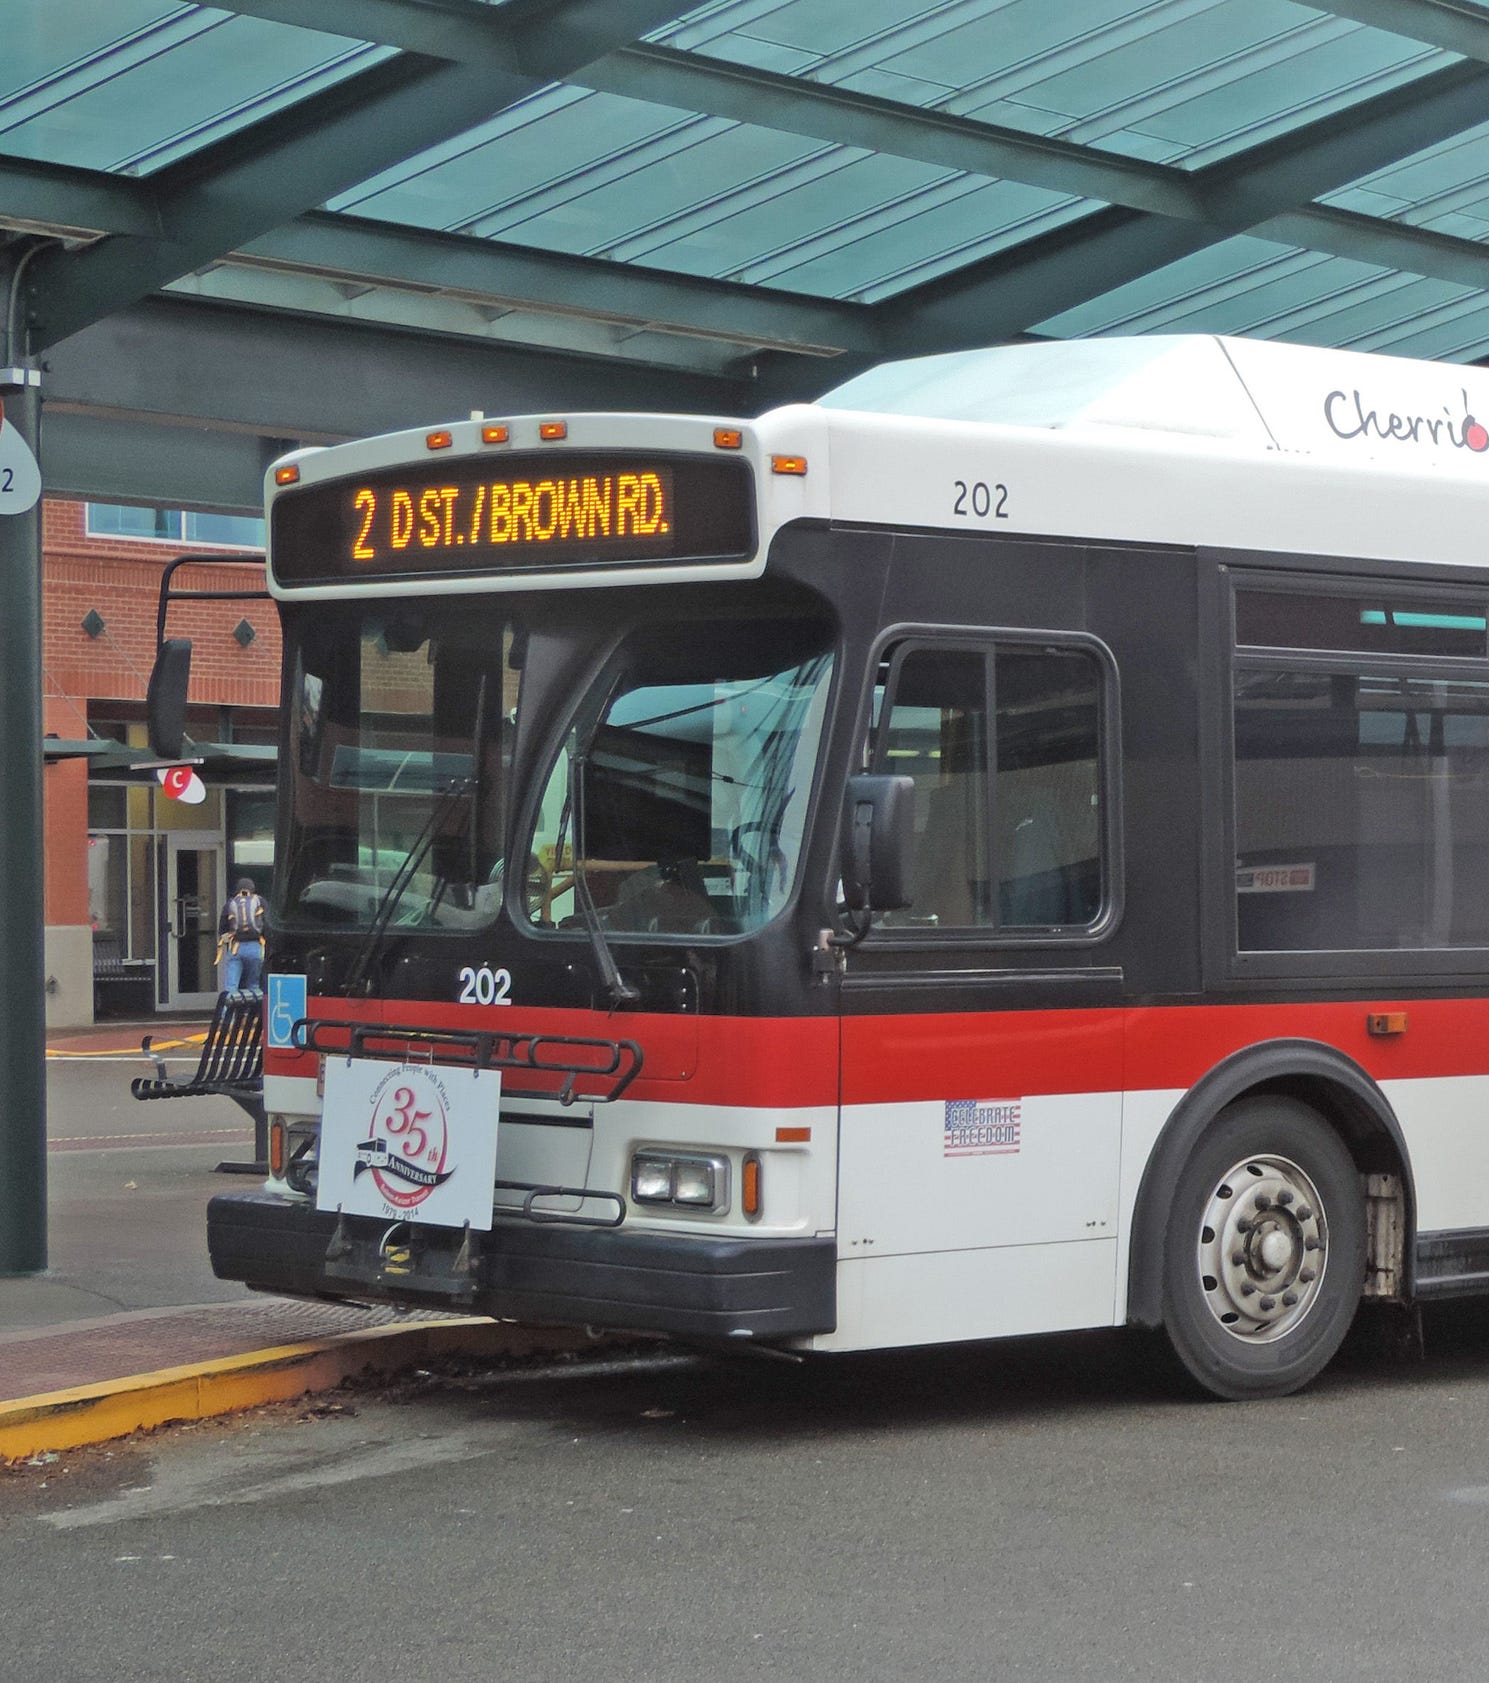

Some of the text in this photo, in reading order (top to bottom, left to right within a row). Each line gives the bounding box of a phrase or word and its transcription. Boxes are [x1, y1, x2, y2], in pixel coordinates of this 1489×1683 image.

[954, 480, 1009, 518] 202
[353, 490, 376, 560] 2
[618, 473, 669, 535] RD.
[172, 771, 184, 788] C
[459, 967, 512, 1006] 202
[951, 1106, 1015, 1127] CELEBRATE
[951, 1125, 1014, 1145] FREEDOM
